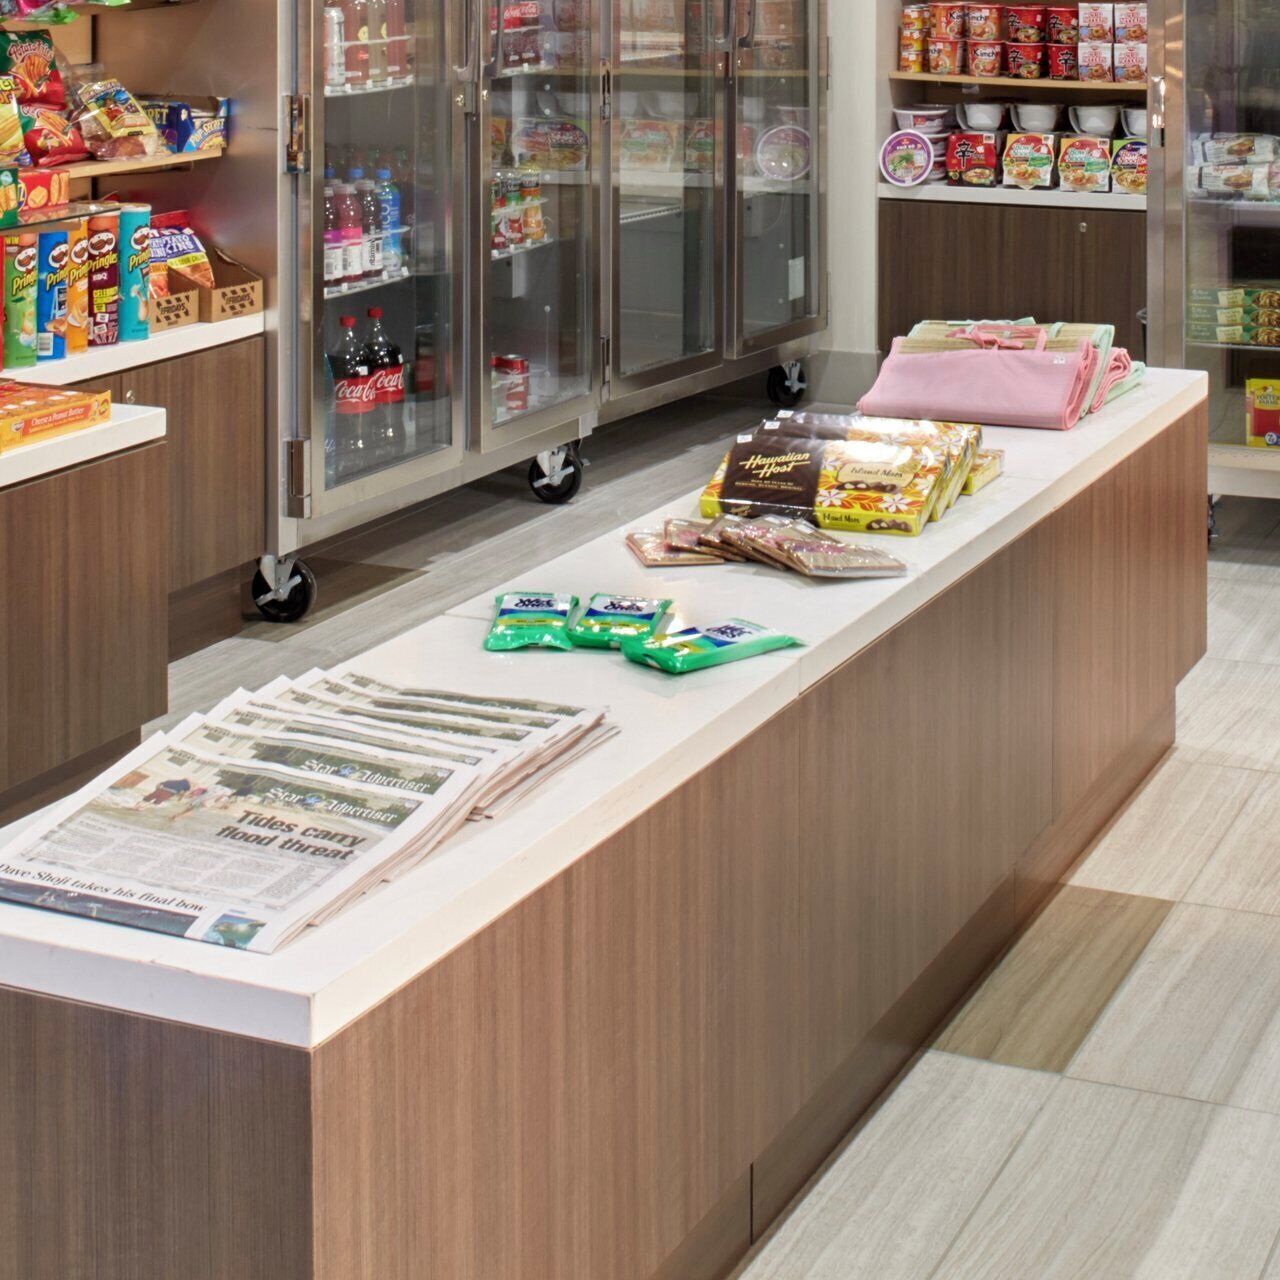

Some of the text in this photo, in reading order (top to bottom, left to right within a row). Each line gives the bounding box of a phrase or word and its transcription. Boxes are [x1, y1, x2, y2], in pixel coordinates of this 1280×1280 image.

[88, 253, 118, 271] Pringles
[739, 452, 810, 470] Hawaiian
[752, 462, 794, 478] Host
[299, 759, 339, 779] Star
[267, 787, 304, 804] Star
[236, 810, 368, 848] Tides carry
[216, 825, 355, 860] flood threat
[33, 871, 71, 888] Shoji
[70, 879, 111, 894] takes
[116, 887, 137, 899] his
[138, 892, 175, 906] final
[175, 898, 208, 912] bow
